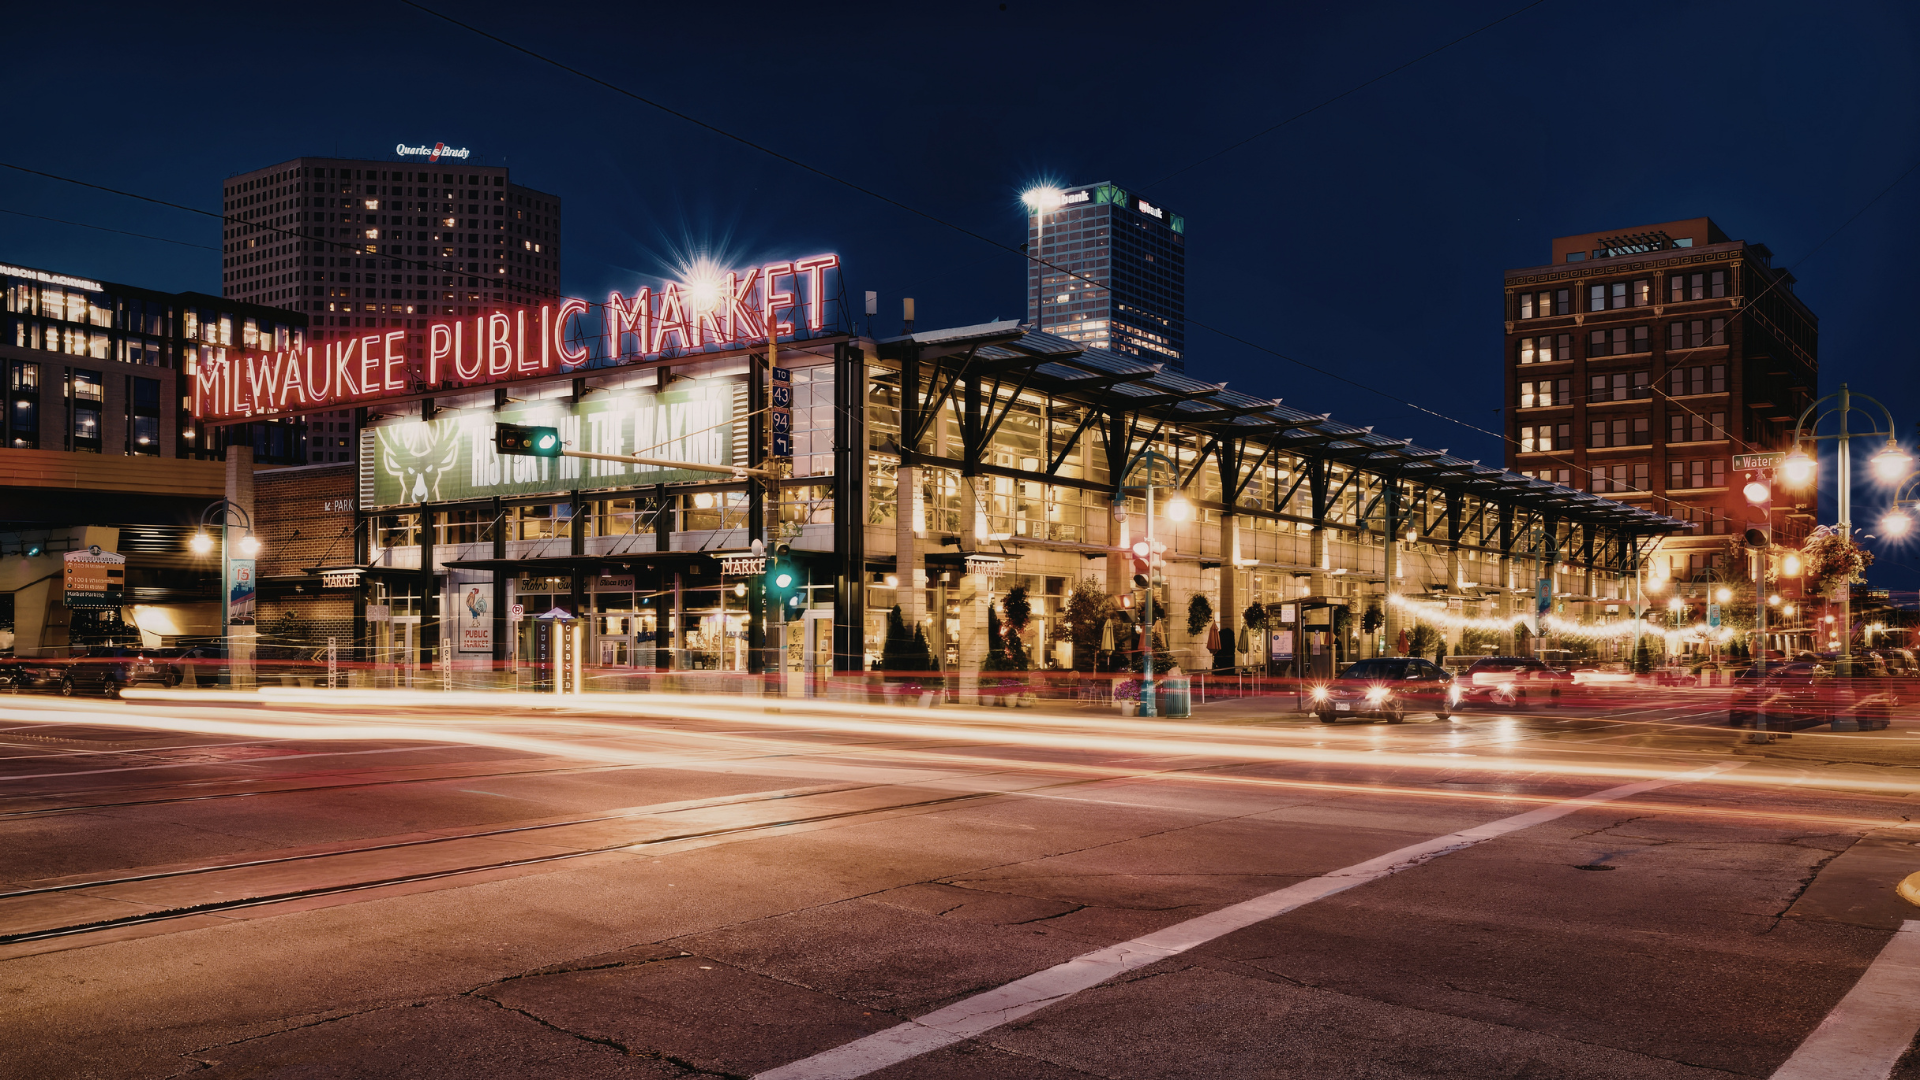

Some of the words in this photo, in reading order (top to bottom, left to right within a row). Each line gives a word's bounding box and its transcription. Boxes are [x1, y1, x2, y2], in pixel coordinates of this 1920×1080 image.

[441, 146, 470, 159] Brady
[195, 330, 405, 417] MILWAUKEE
[429, 299, 590, 385] PUBLIC
[610, 253, 839, 359] MARKET
[777, 370, 787, 379] TO
[774, 387, 788, 403] 43
[773, 413, 787, 428] 94
[560, 415, 580, 480] IN
[588, 410, 626, 478] THE
[633, 398, 724, 473] MAKING
[1743, 456, 1773, 467] Water
[334, 499, 354, 512] PARK
[722, 558, 767, 575] MARKE
[323, 573, 360, 587] MARKET
[465, 630, 489, 638] PUBLIC
